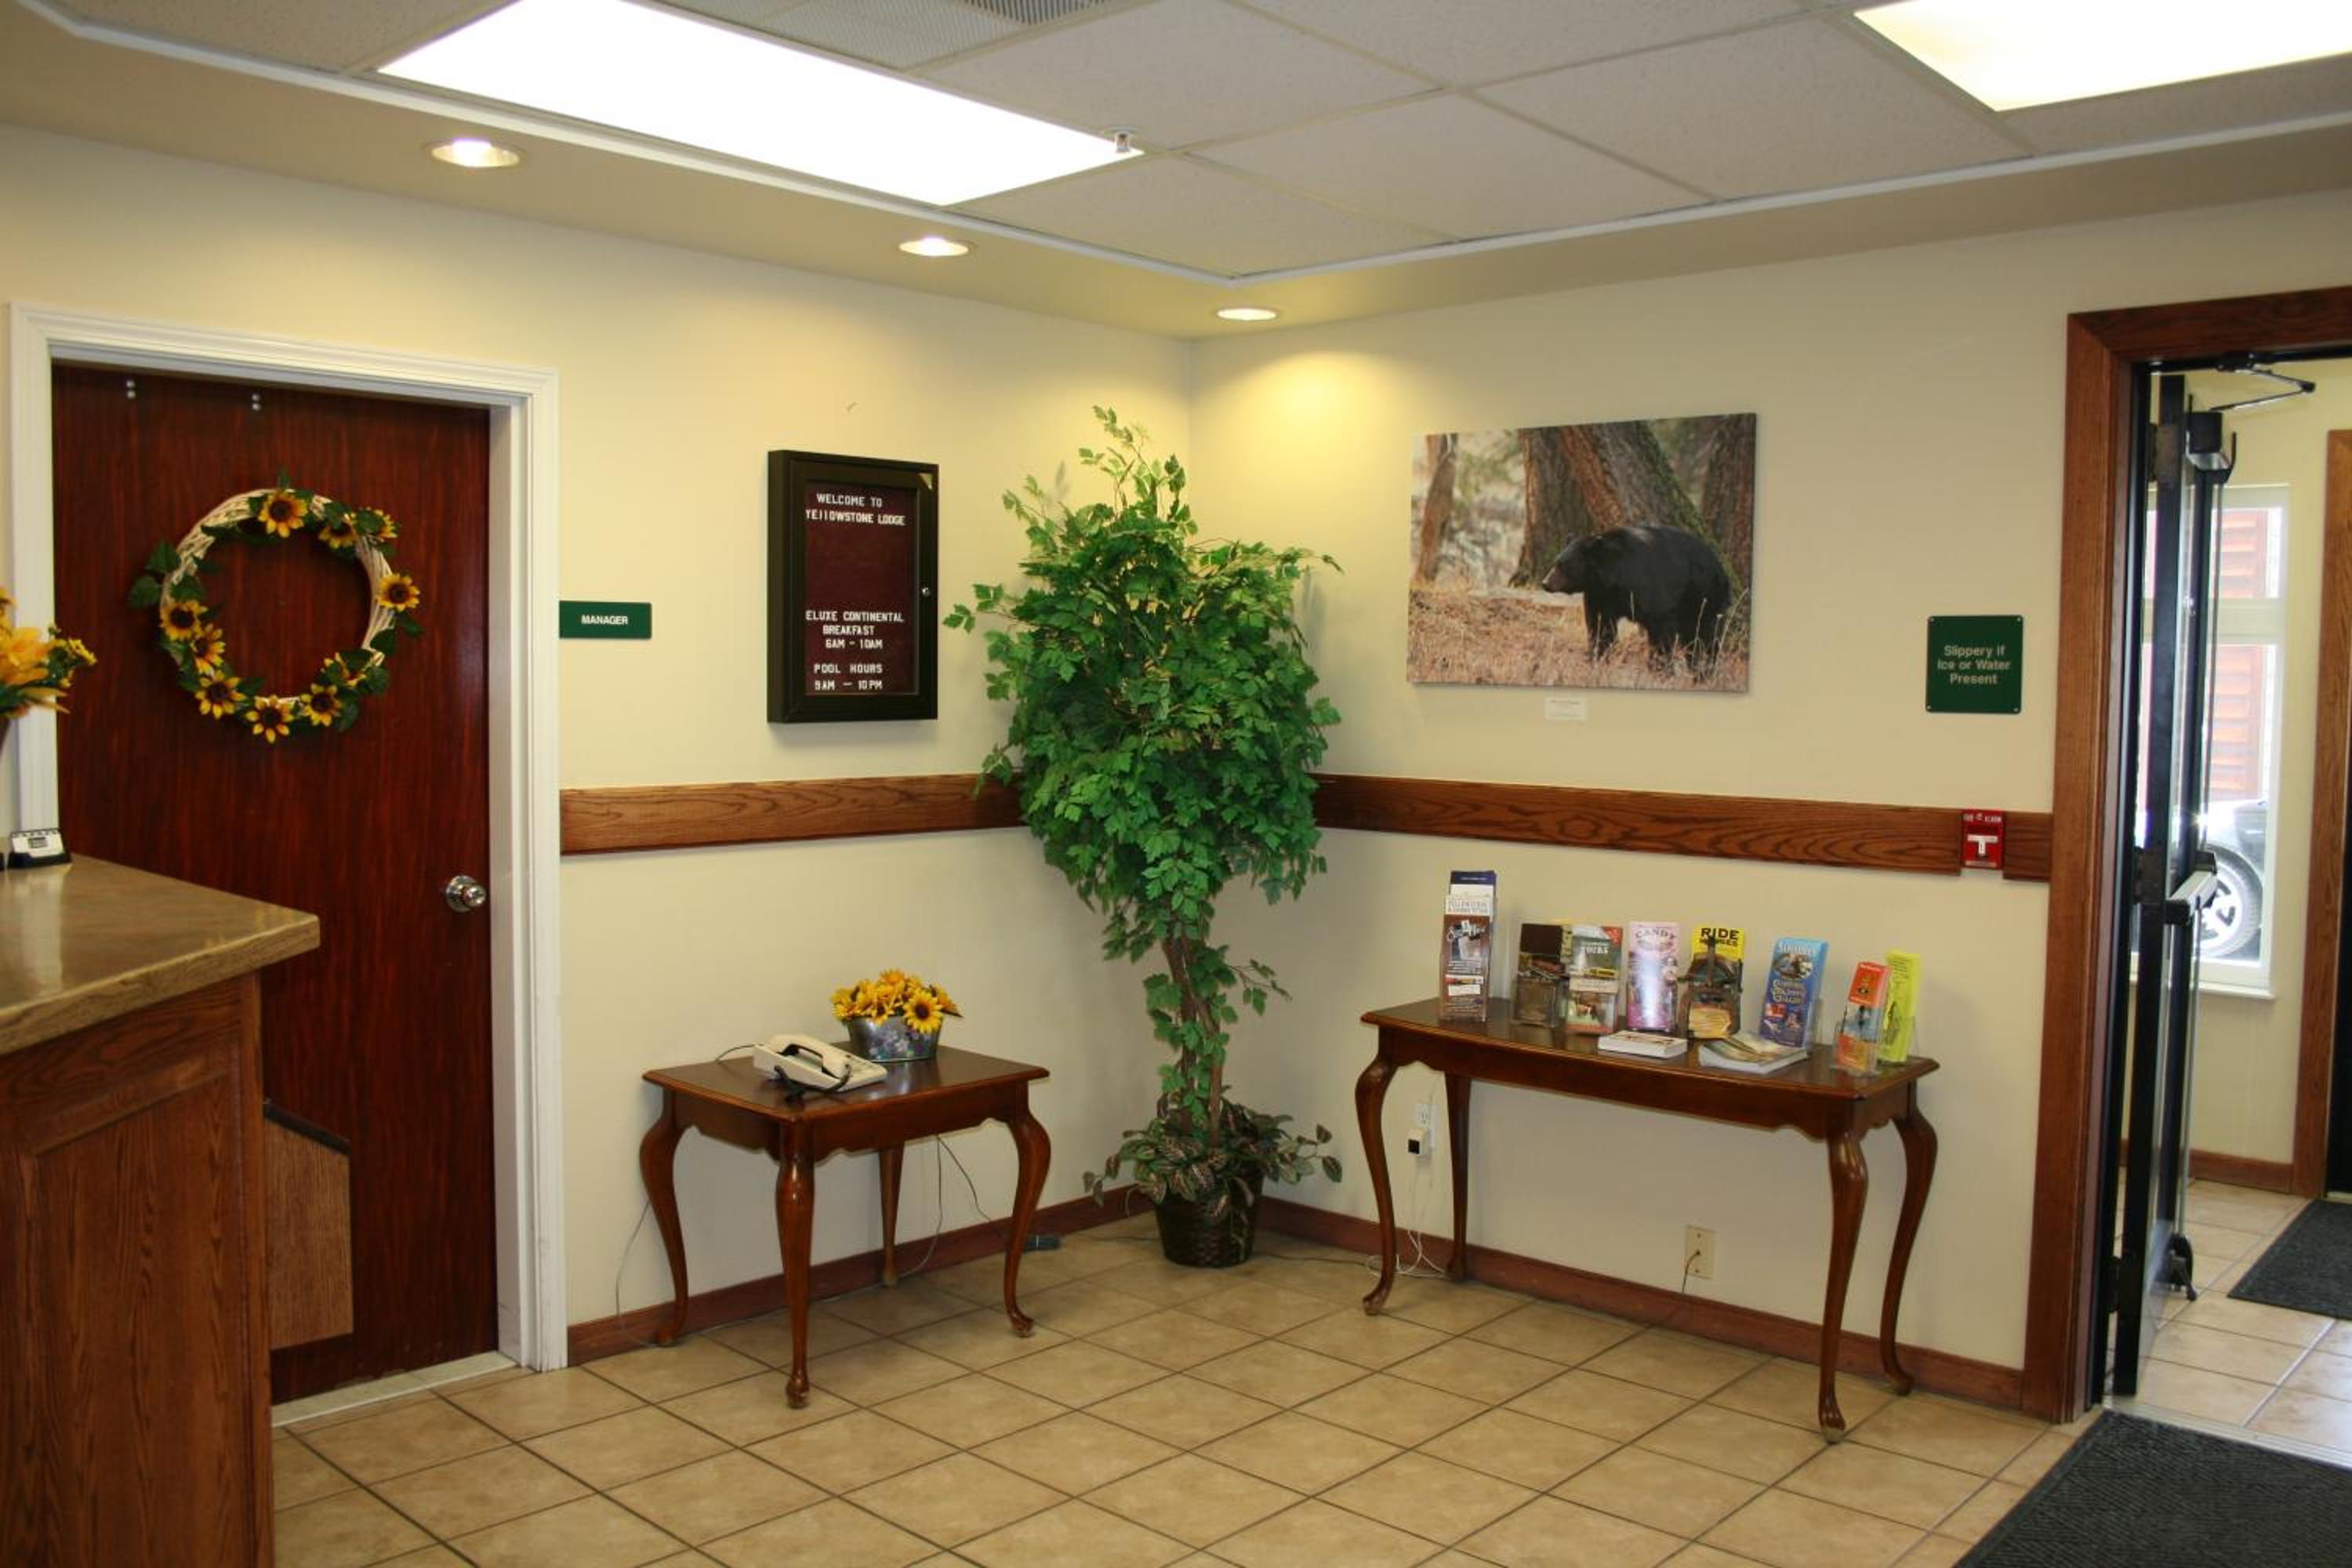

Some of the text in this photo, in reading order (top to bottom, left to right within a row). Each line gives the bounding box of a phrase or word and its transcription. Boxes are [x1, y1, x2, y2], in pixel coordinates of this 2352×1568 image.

[816, 493, 883, 508] WELCOME TO
[877, 514, 906, 525] LODGE
[581, 614, 629, 625] MANAGER
[805, 610, 904, 622] ELUXE CONTINENTAL
[822, 625, 876, 636] BREAKFAST
[826, 639, 846, 649] 6AM
[860, 639, 884, 649] 10AM
[1944, 644, 1993, 659] Slippery
[814, 663, 884, 673] POOL HOURS
[1937, 658, 2011, 670] Ice or Water
[1950, 673, 1998, 685] Present
[1700, 927, 1740, 940] RIDE
